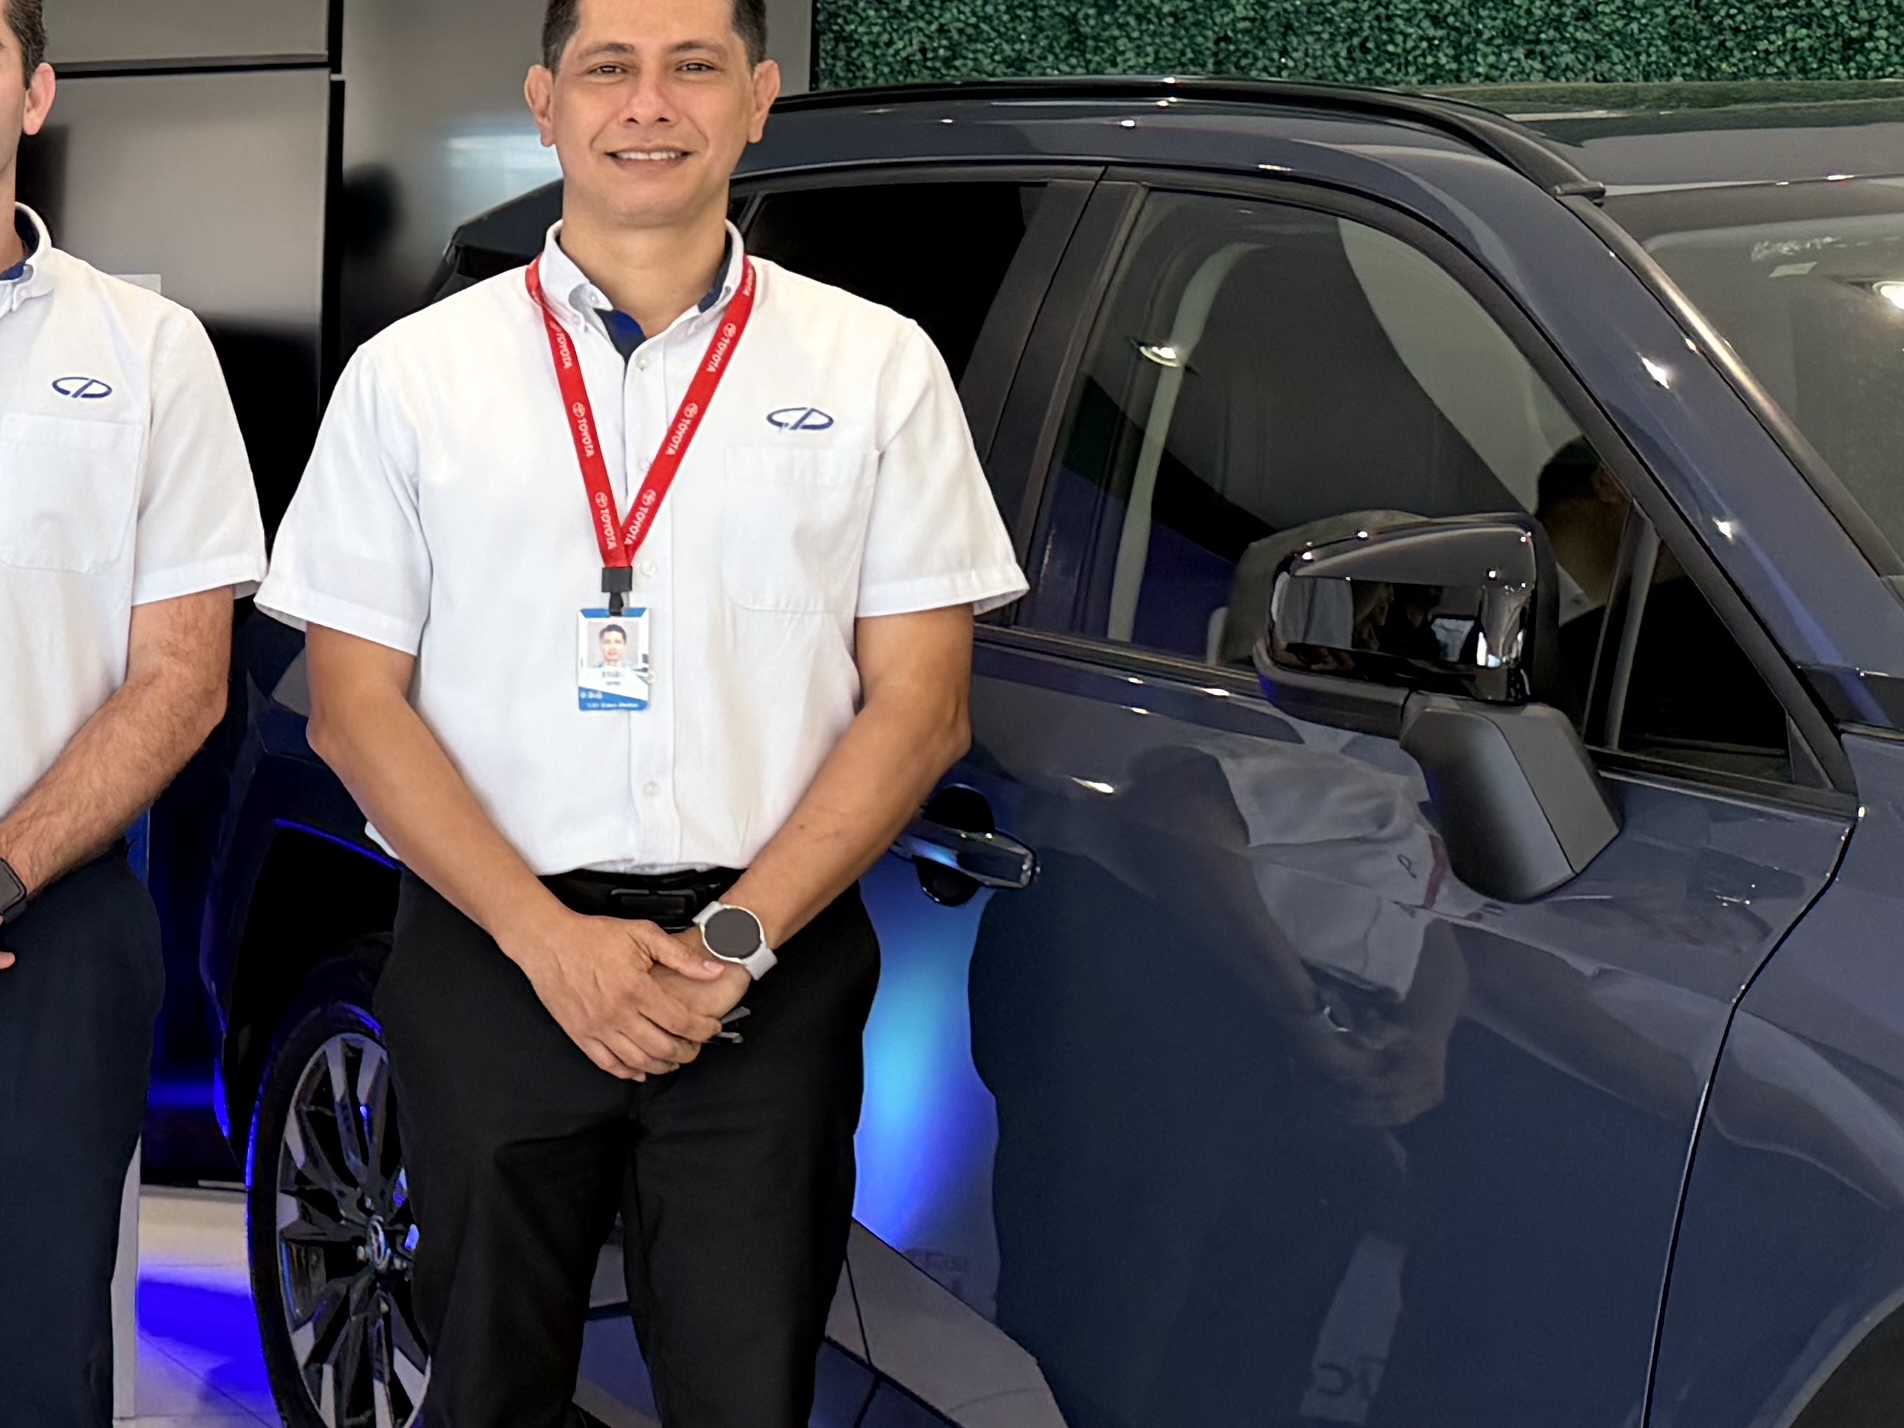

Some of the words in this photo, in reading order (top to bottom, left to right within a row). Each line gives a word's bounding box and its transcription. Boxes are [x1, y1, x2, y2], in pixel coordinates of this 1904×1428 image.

[577, 418, 595, 458] TOYOTA
[666, 419, 690, 456] TOYOTA
[600, 509, 616, 551] TOYOTA
